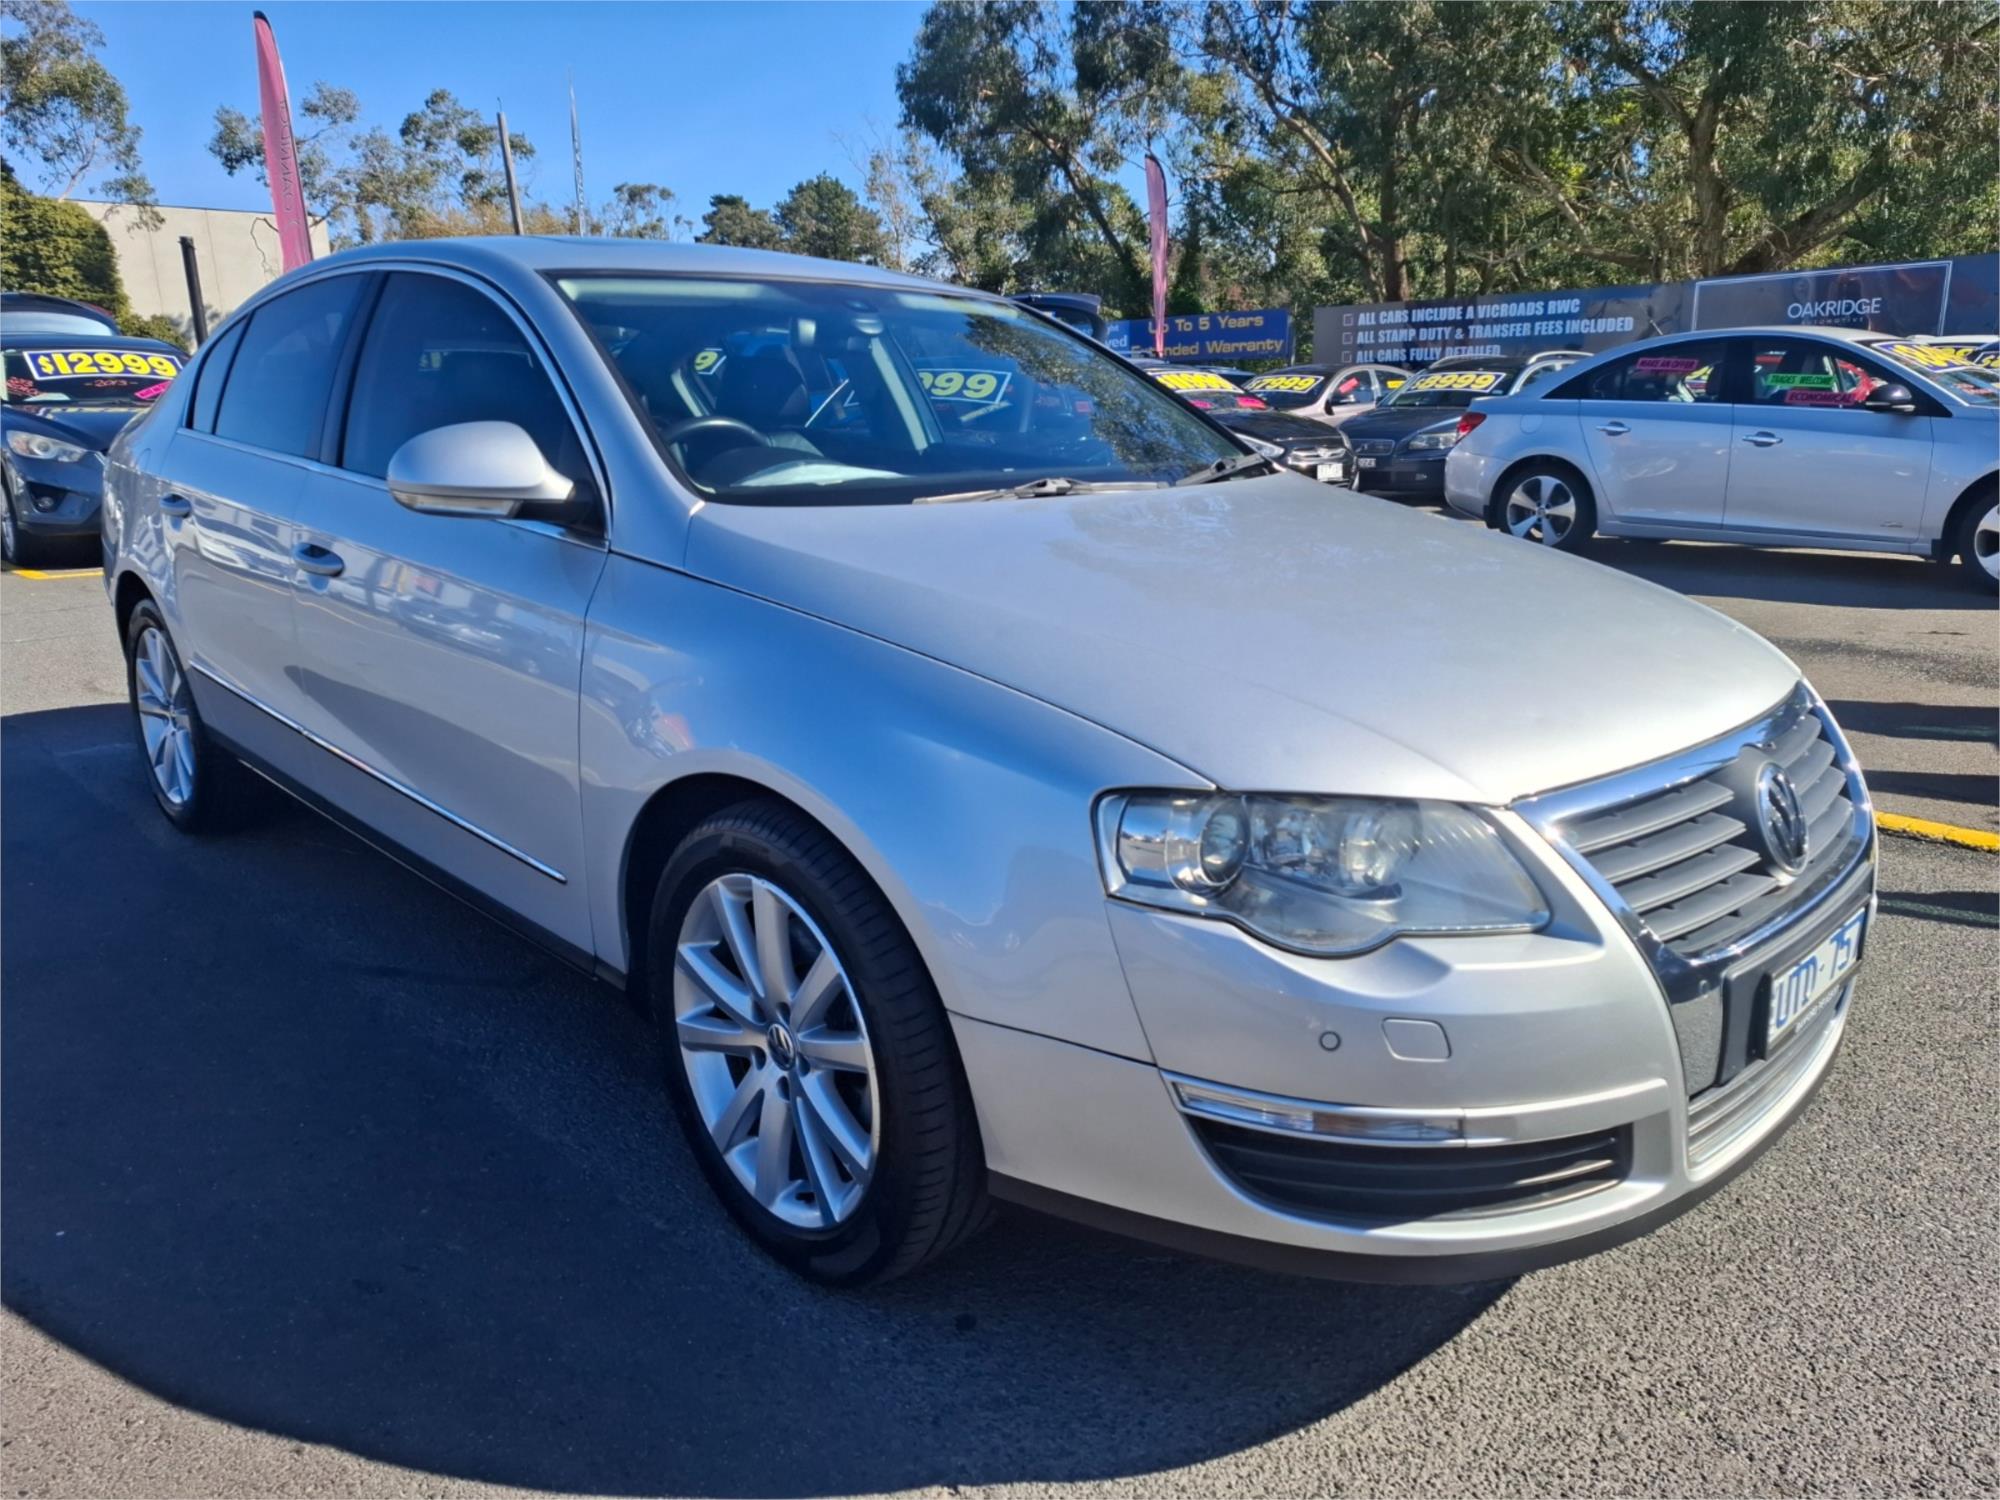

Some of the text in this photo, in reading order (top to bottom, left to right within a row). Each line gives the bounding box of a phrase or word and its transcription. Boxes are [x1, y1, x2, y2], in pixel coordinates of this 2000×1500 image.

[1357, 298, 1581, 326] ALL CARS INCLUDE A VICROADS RWC
[1787, 297, 1882, 319] OAKRIDGE
[1175, 318, 1193, 331] To
[1198, 316, 1210, 330] 5
[1217, 314, 1264, 329] Years
[1356, 317, 1634, 345] ALL STAMP DUTY & TRANSFER FEES INCLUDED
[1205, 338, 1284, 354] Warranty
[1355, 349, 1375, 363] ALL
[1377, 348, 1407, 362] CARS
[1409, 346, 1442, 362] FULLY
[38, 352, 177, 377] $12999
